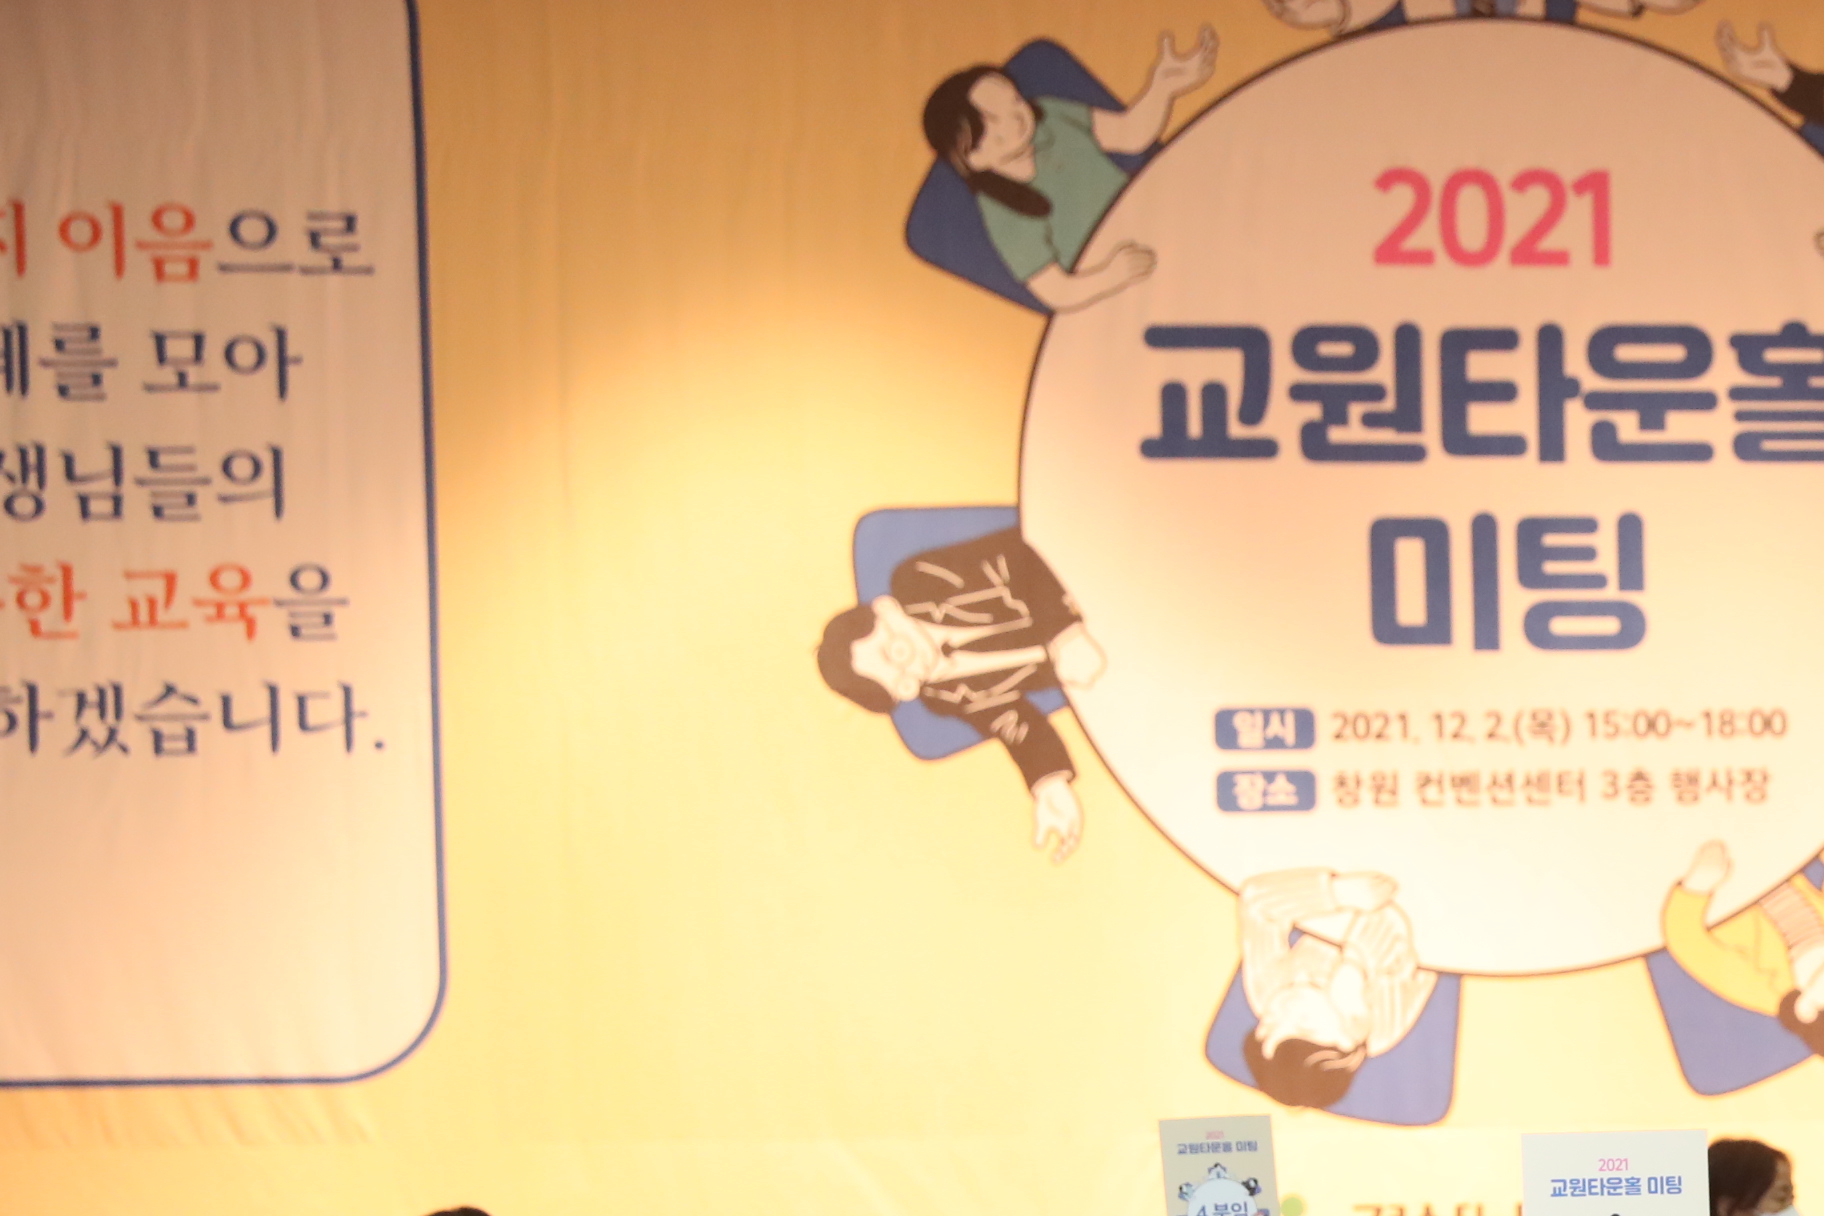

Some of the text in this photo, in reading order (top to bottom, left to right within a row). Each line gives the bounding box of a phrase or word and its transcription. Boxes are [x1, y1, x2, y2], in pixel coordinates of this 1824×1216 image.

[58, 199, 376, 284] 이음으로
[1372, 167, 1612, 267] 2021
[142, 322, 304, 402] 모아
[0, 440, 286, 522] 생님들의
[0, 560, 351, 642] 한 교육을
[1369, 511, 1647, 650] 미팅
[0, 680, 386, 757] 하겠습니다.
[1232, 709, 1297, 749] 일시
[1331, 709, 1421, 744] 2021.
[1432, 711, 1477, 743] 12.
[1585, 708, 1788, 740] 15:00~18:00
[1233, 766, 1772, 811] 장소 창원 컨벤션센터 3층 행사장
[1177, 1141, 1258, 1155] 교원타운홀 미팅
[1550, 1175, 1682, 1197] 교원타운홀 미팅
[1598, 1158, 1630, 1172] 2021
